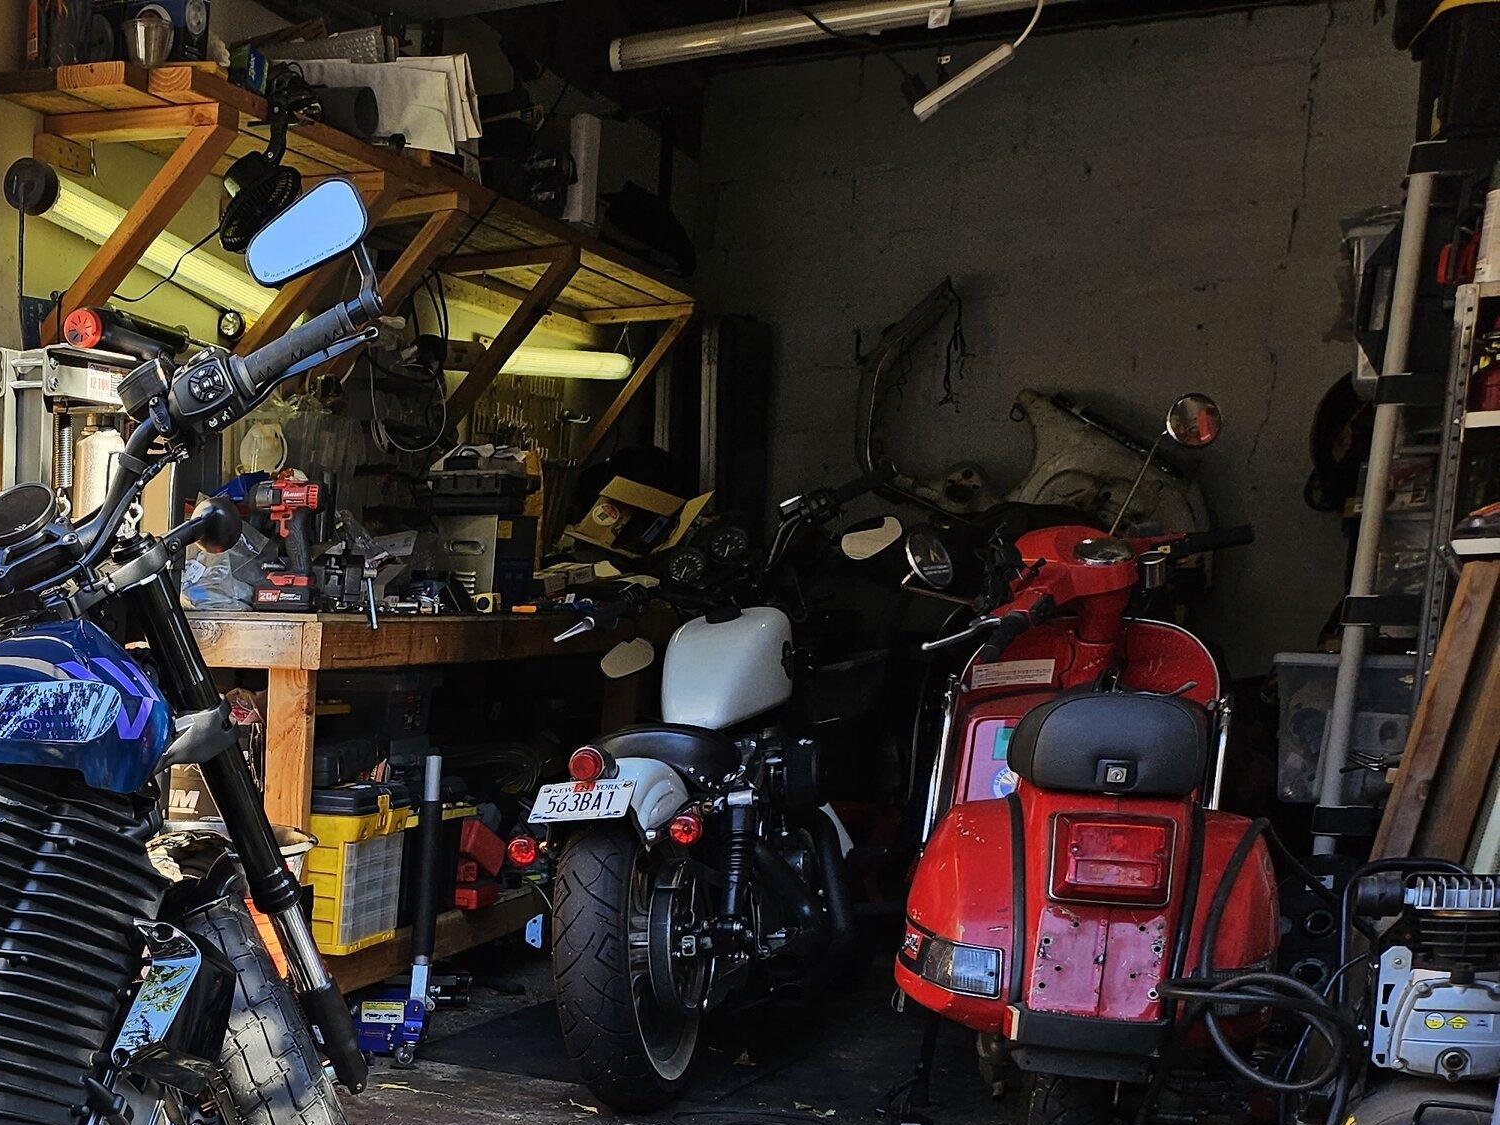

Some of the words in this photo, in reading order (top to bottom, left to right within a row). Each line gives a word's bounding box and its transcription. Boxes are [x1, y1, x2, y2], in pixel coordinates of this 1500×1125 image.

[552, 787, 574, 795] NEW
[596, 782, 621, 791] YORK
[545, 791, 615, 814] 563BA1
